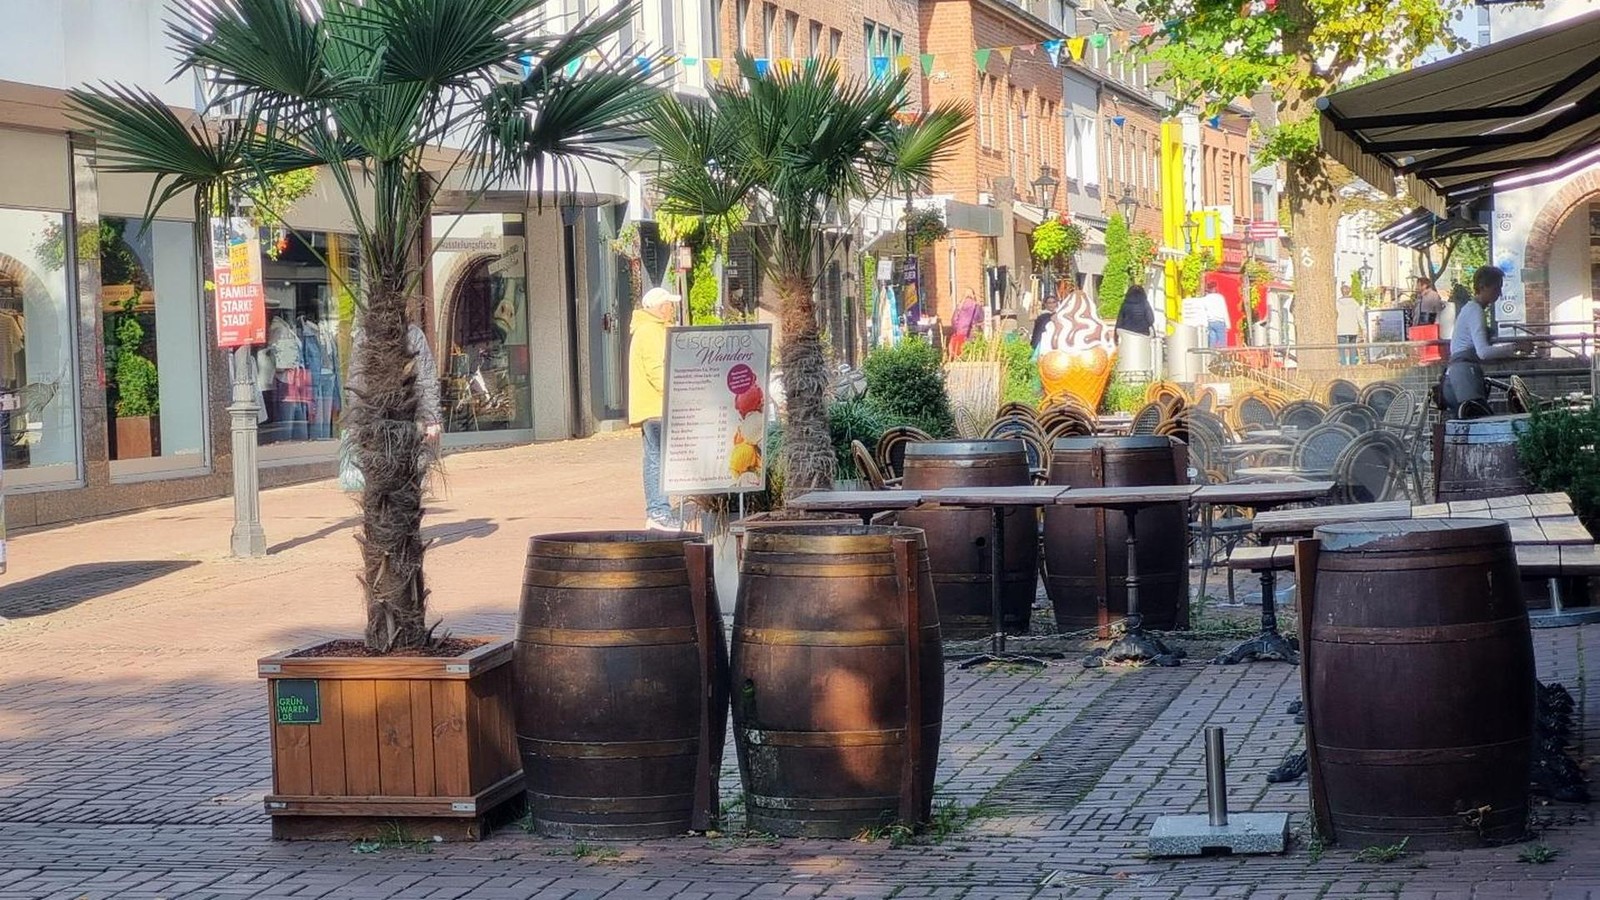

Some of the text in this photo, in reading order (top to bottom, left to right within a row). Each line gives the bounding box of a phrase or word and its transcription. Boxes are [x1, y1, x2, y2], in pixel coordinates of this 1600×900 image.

[222, 299, 254, 313] STARKE
[675, 332, 752, 351] Eiscreme
[696, 346, 754, 365] Wanders
[280, 696, 303, 705] GRÜN
[280, 705, 308, 713] WAREN
